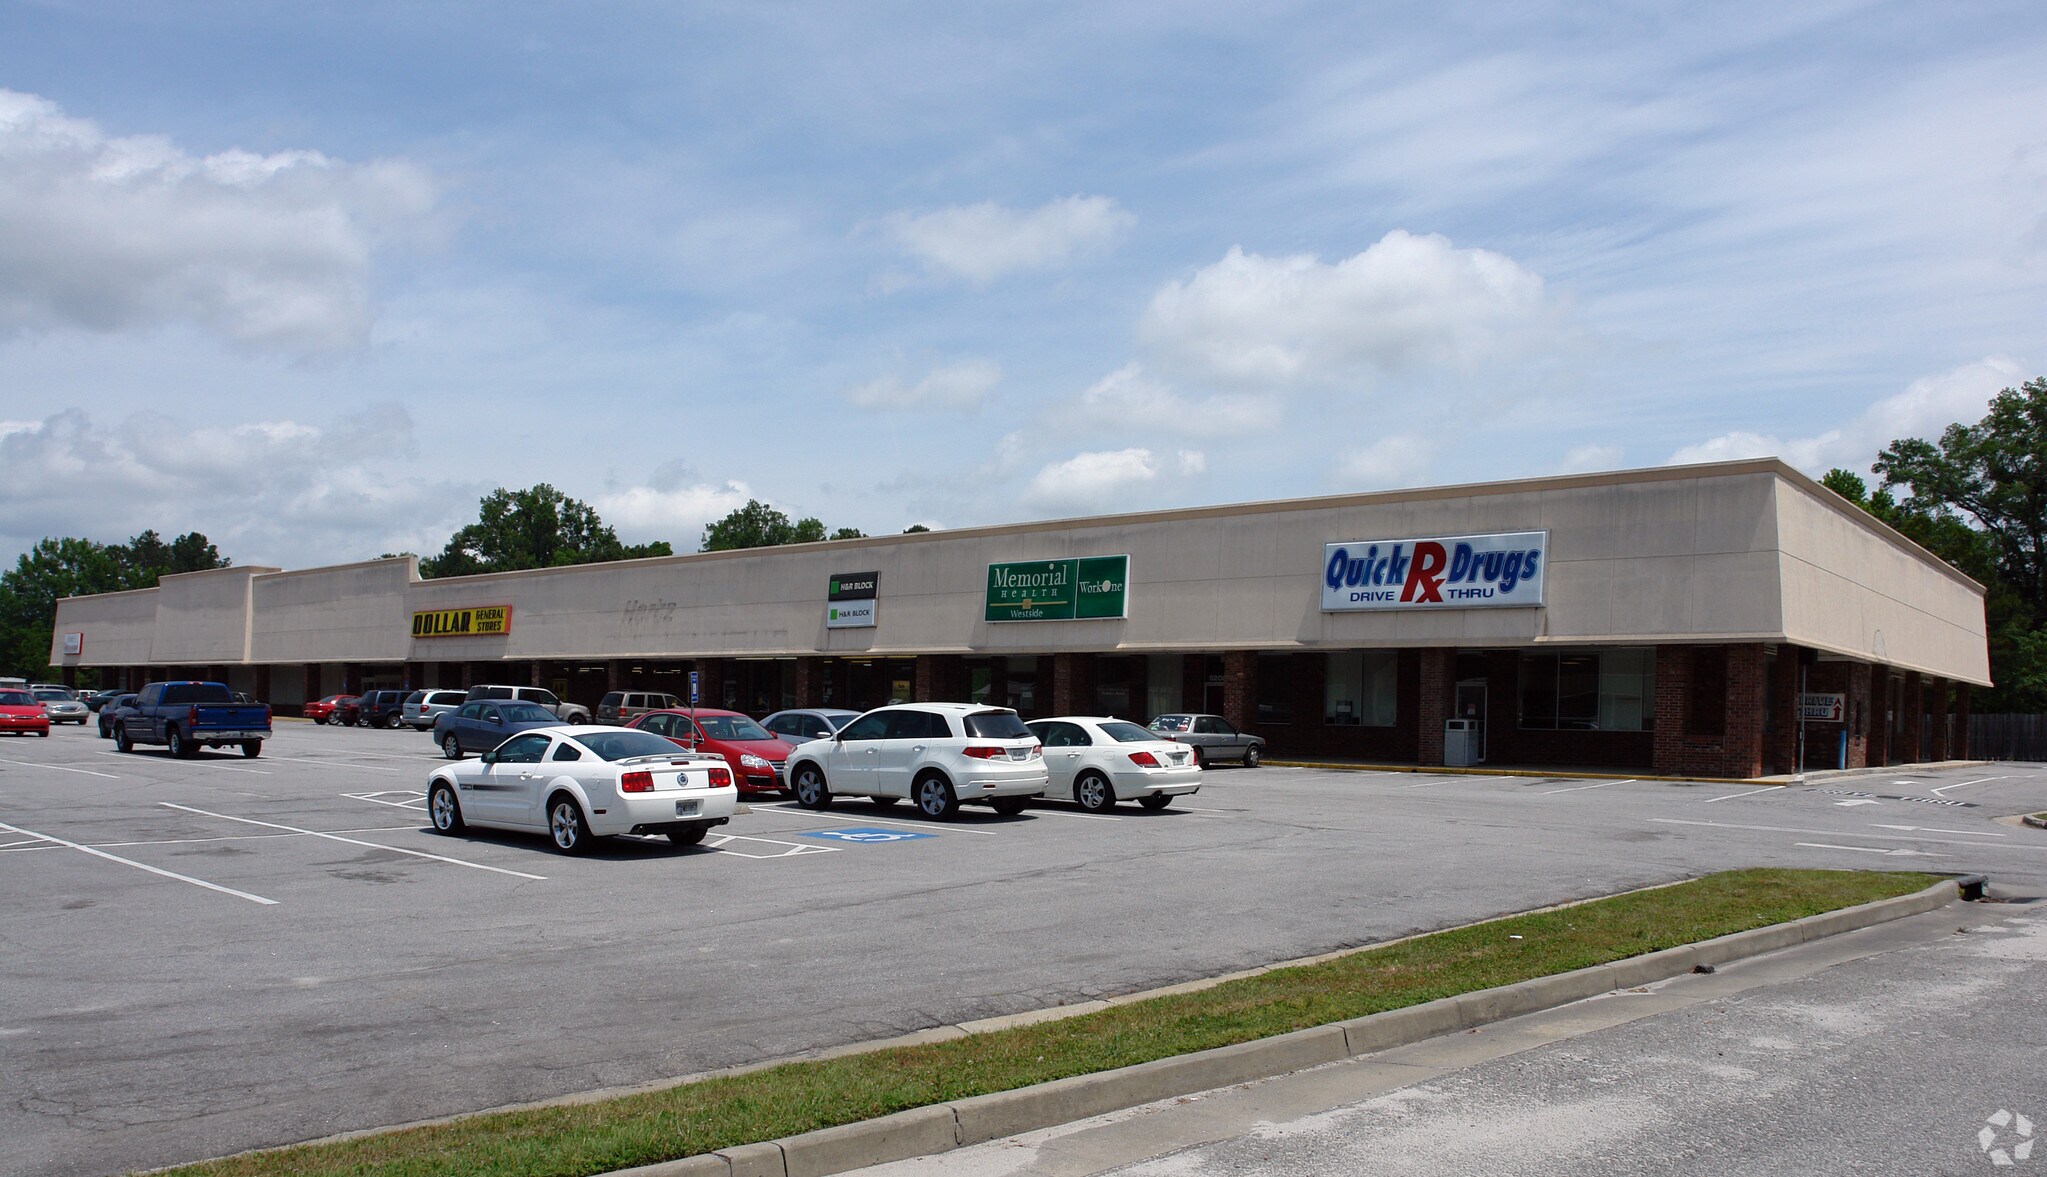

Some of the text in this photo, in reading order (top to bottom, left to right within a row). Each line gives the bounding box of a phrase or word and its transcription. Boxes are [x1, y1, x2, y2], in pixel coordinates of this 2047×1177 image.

[1325, 544, 1411, 593] Quick
[1446, 541, 1542, 594] Drugs
[993, 563, 1067, 588] Memorial
[841, 581, 874, 591] H&R BLOCK
[1079, 580, 1123, 594] WorkOne
[1350, 588, 1494, 602] DRIVE THRU
[475, 609, 504, 620] GENERAL
[852, 609, 871, 617] BLOCK
[1010, 608, 1043, 618] Westside
[412, 611, 471, 635] DOLLAR
[477, 620, 502, 632] STORES
